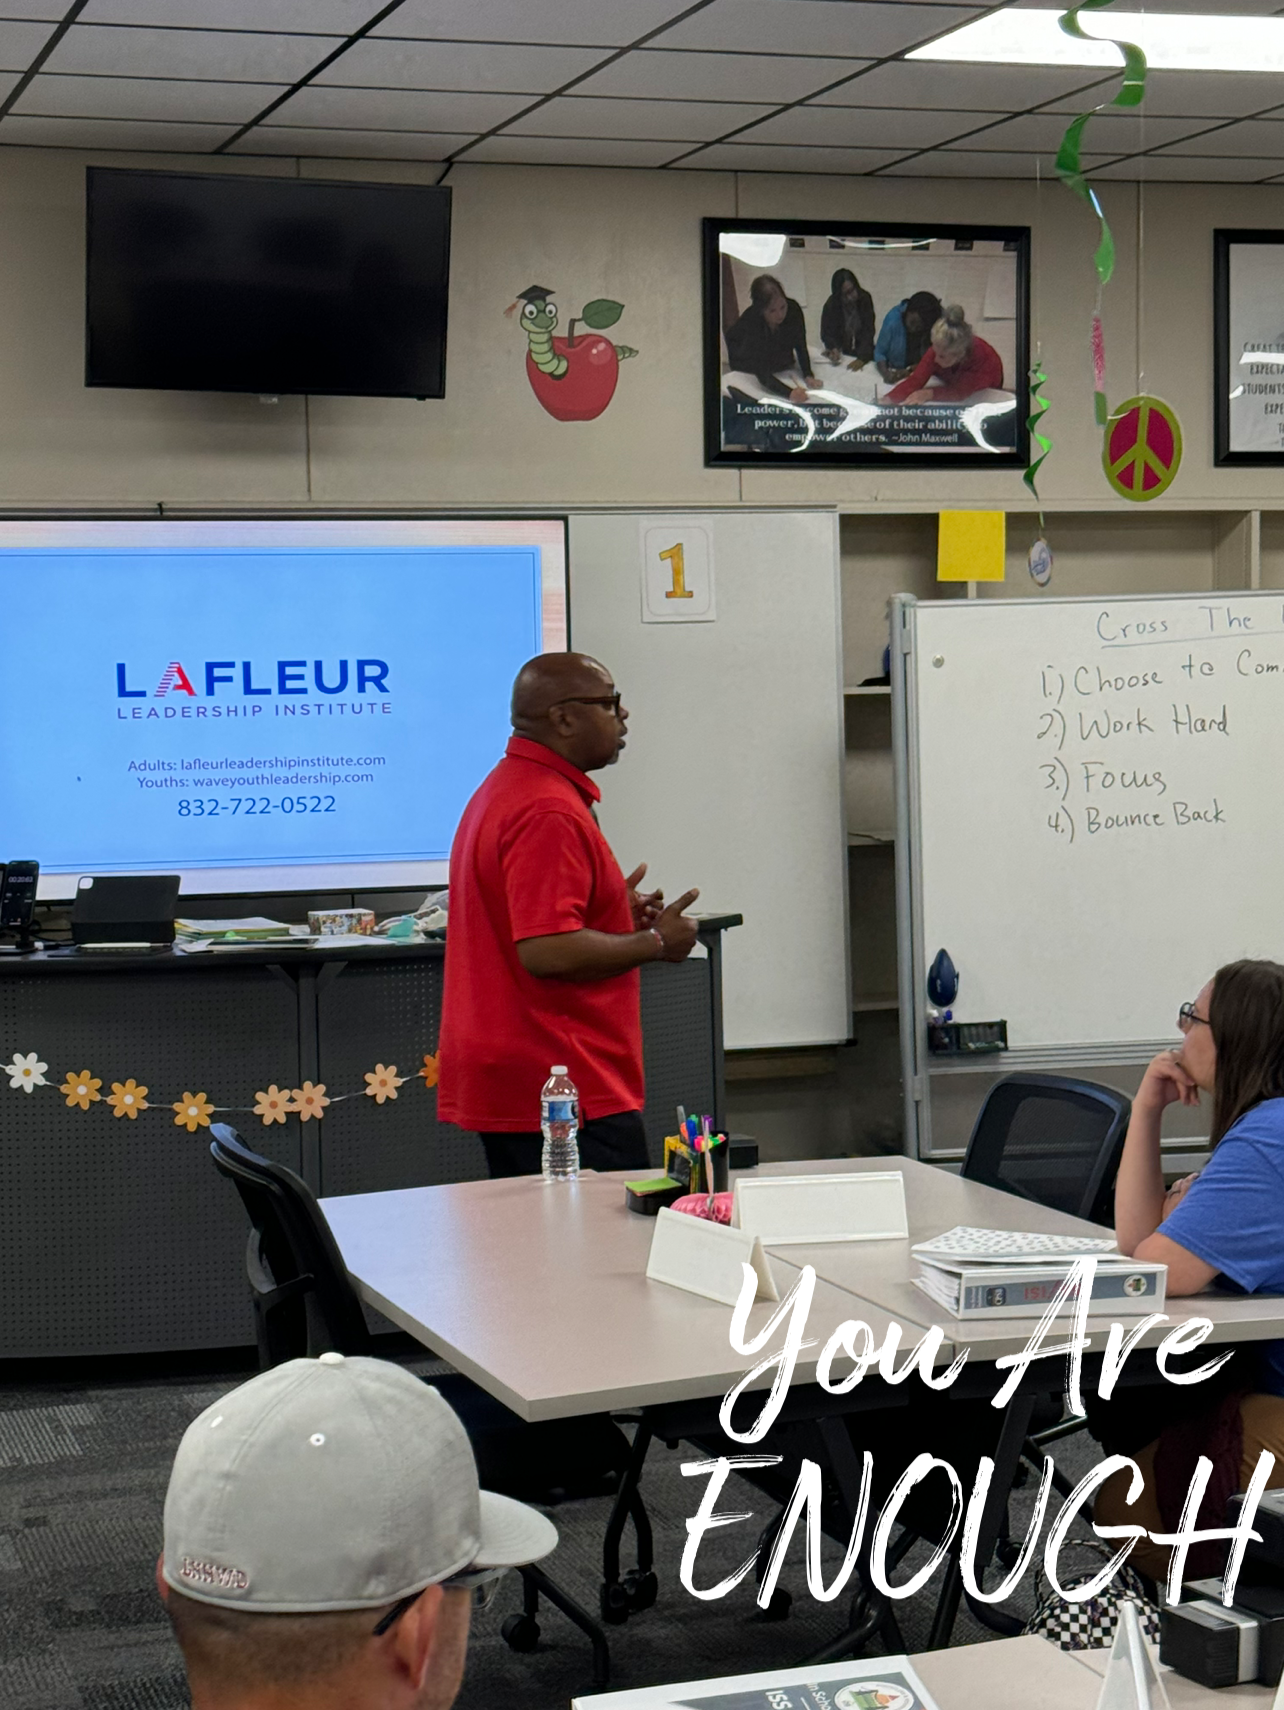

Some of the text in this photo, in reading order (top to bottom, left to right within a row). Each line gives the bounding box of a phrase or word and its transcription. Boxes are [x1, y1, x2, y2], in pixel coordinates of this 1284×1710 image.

[736, 404, 791, 415] Leaders
[901, 405, 954, 416] because
[754, 419, 798, 430] power,
[799, 417, 821, 429] bt
[876, 418, 892, 430] of
[893, 418, 925, 430] their
[841, 432, 888, 443] others.
[921, 433, 958, 443] Maxwell
[658, 542, 694, 599] 1
[1096, 611, 1169, 641] Cross
[1198, 606, 1254, 632] The
[115, 659, 391, 699] LAFLEUR
[1074, 665, 1163, 696] Choose
[116, 702, 393, 720] LEADERSHIP INSTITUTE
[1078, 708, 1154, 741] Work
[1171, 704, 1230, 736] Hard
[127, 755, 386, 772] Adults: lafleurleadershipinstitute.com
[136, 772, 374, 789] Youths: waveyouthleadership.com
[1081, 761, 1168, 797] Focus
[177, 795, 337, 817] 832-722-0522
[1085, 806, 1165, 835] Bounce
[1172, 798, 1227, 826] Back
